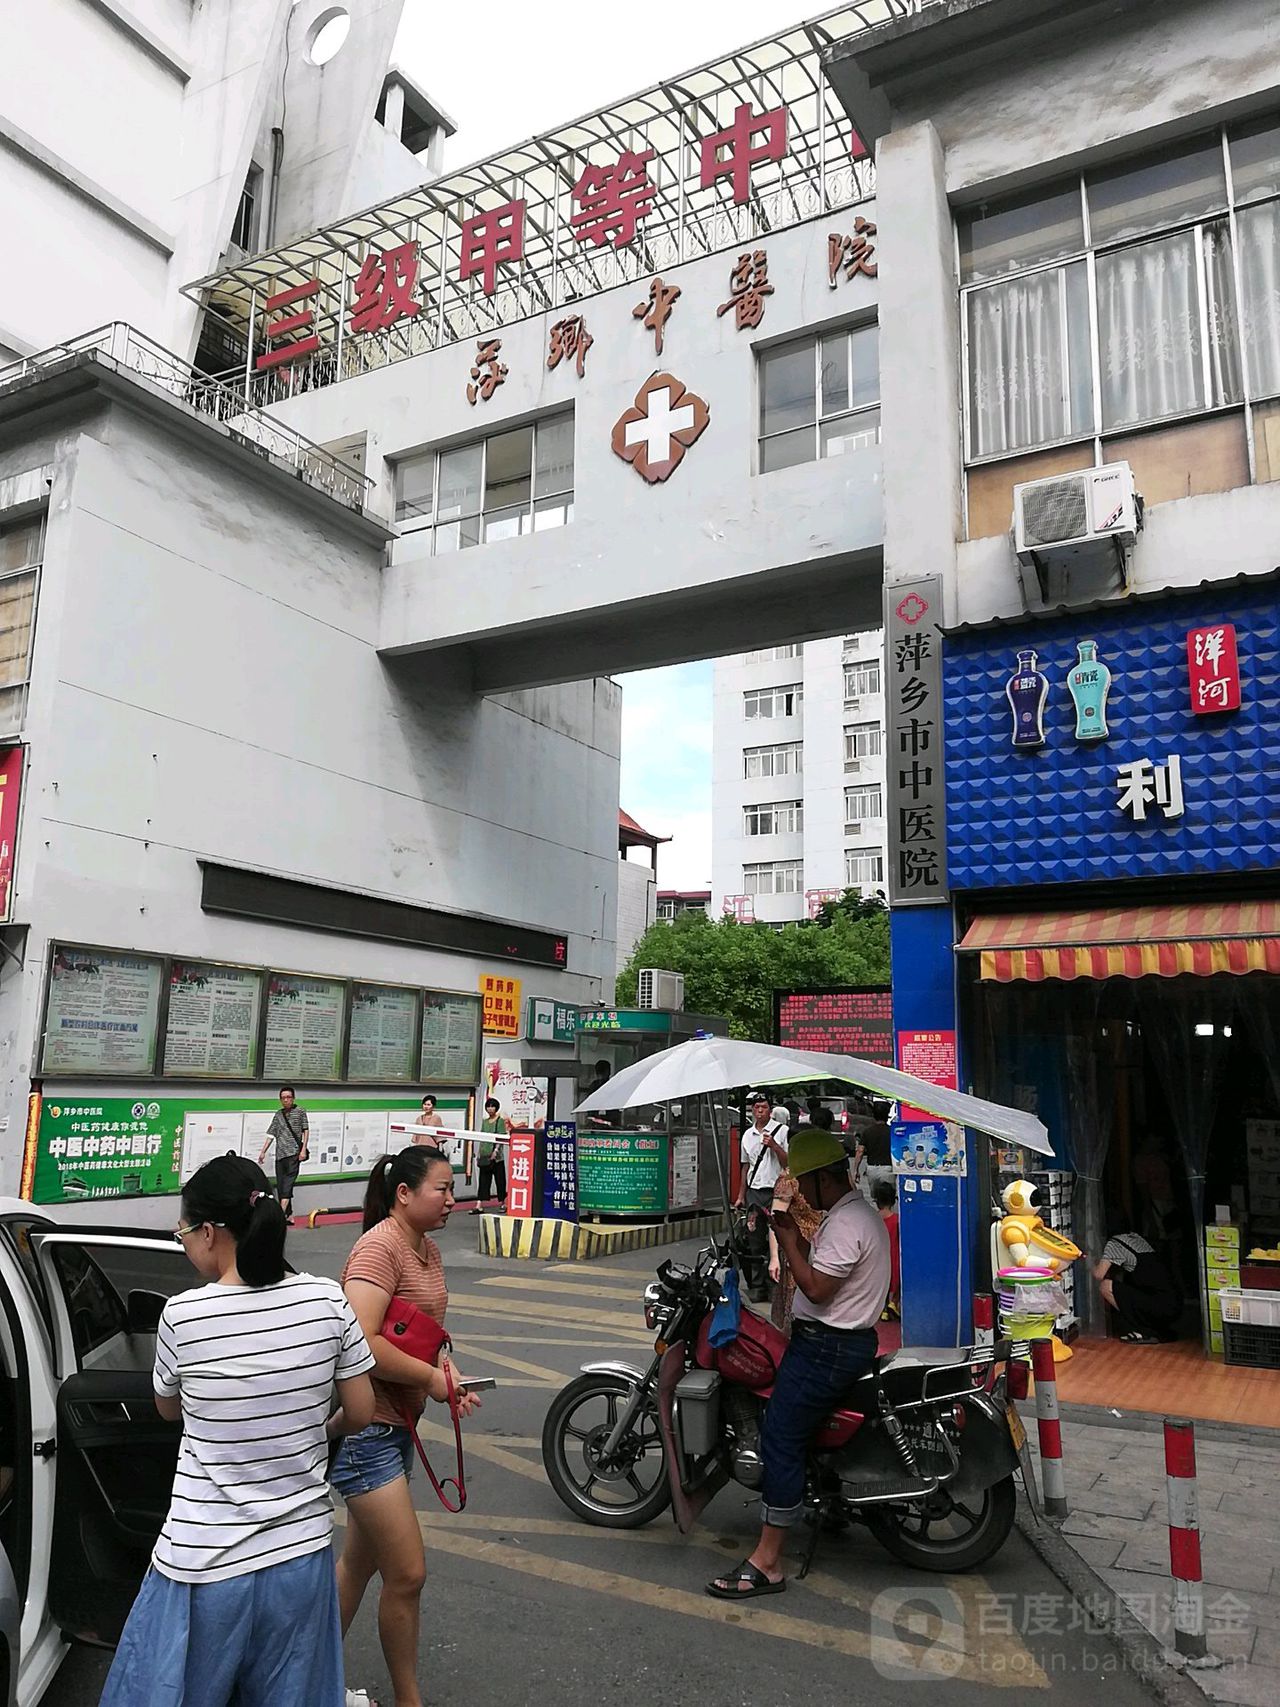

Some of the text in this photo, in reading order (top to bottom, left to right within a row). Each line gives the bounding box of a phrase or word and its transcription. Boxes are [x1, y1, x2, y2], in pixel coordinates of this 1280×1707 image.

[257, 103, 866, 370] 三级甲等中
[1195, 628, 1230, 707] 洋河
[895, 632, 939, 888] 萍乡市中医院
[1116, 754, 1184, 820] 利
[49, 1134, 162, 1158] 中医中药中国行
[511, 1157, 530, 1211] 进口
